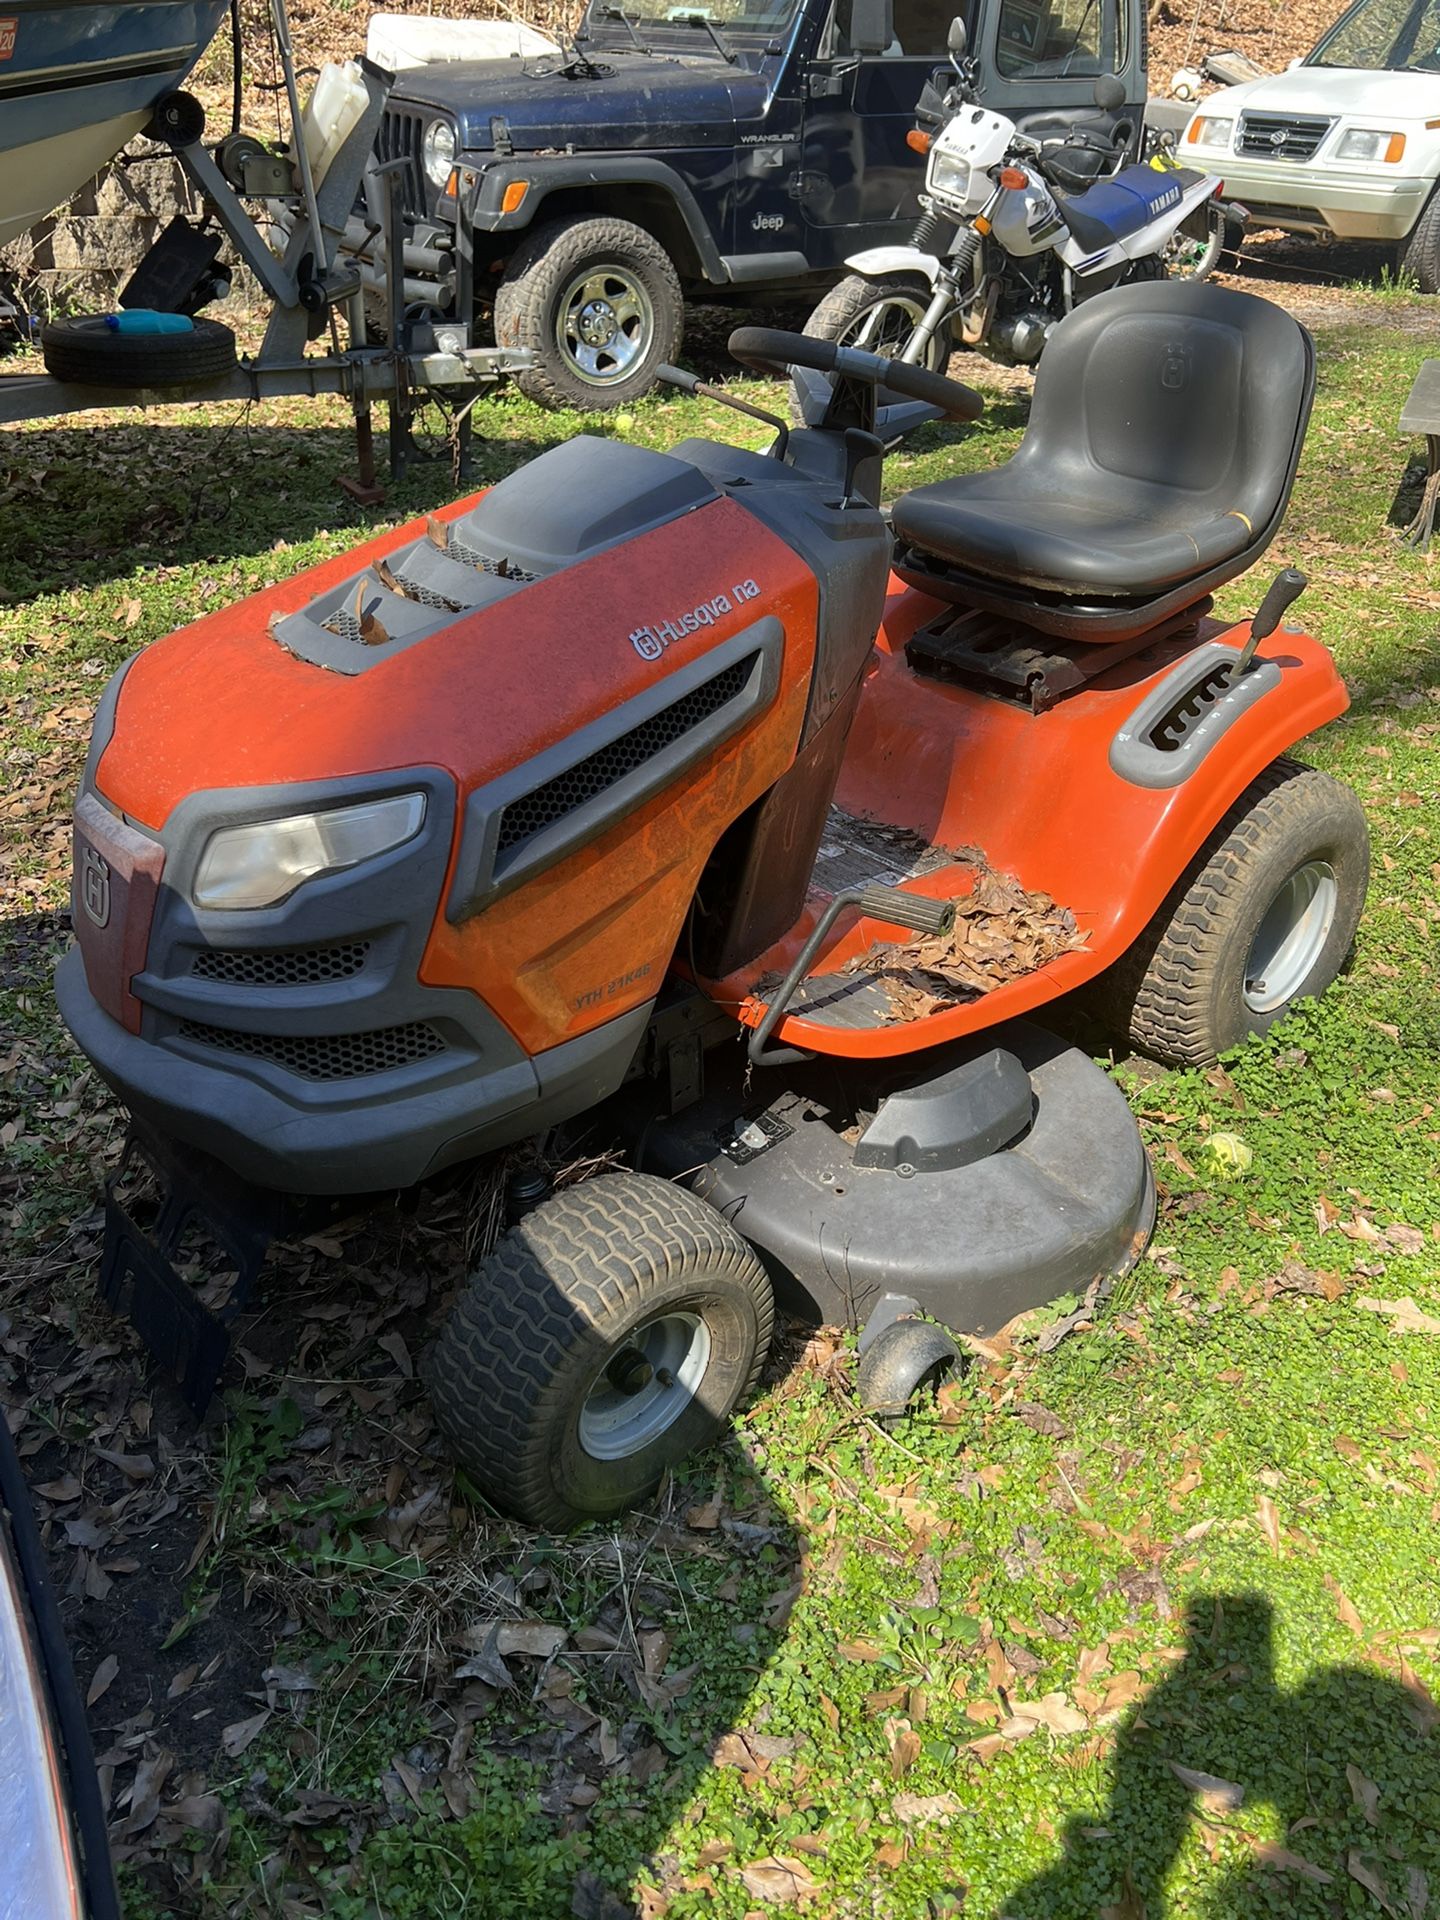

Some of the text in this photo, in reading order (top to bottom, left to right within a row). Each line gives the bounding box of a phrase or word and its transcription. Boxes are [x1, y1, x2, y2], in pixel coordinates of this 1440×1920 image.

[740, 134, 795, 142] WRANGLER
[1149, 185, 1179, 215] YAMAHA
[751, 212, 784, 231] Jeep
[576, 987, 602, 1008] YTH
